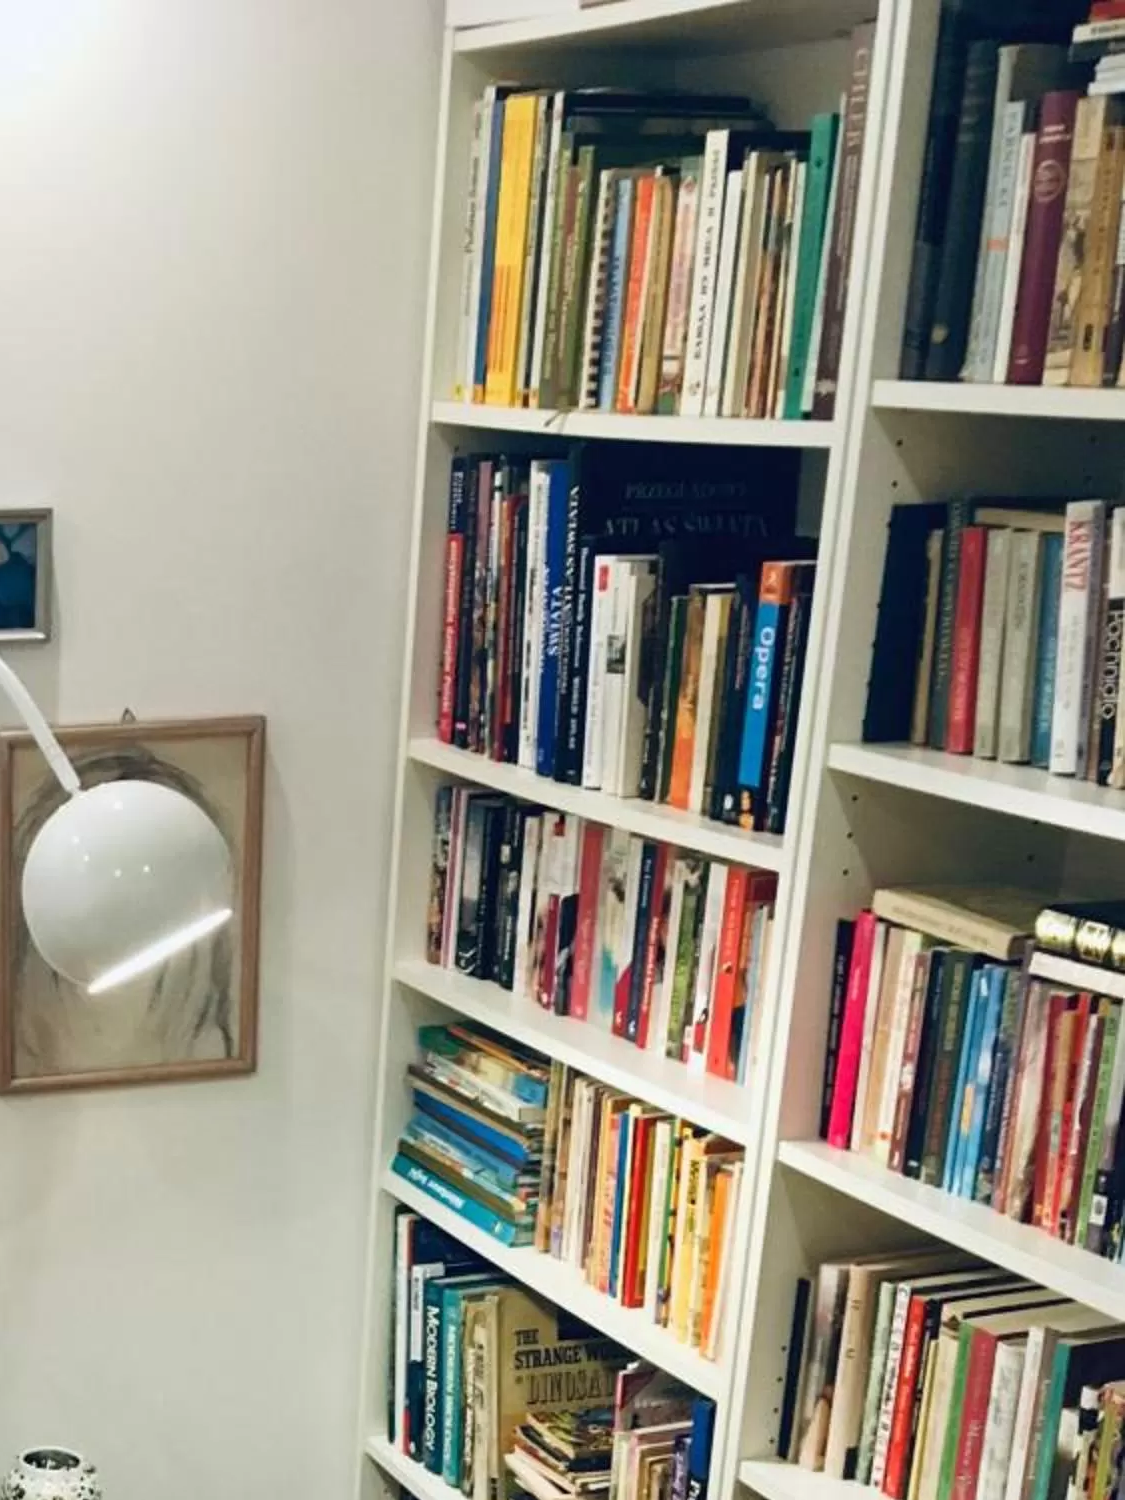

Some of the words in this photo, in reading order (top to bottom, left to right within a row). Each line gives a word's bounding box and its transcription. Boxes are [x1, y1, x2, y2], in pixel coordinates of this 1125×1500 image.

[424, 1304, 441, 1378] MODERN
[514, 1328, 539, 1346] THE
[514, 1344, 582, 1369] STRANGE
[423, 1378, 437, 1451] BIOLOGY
